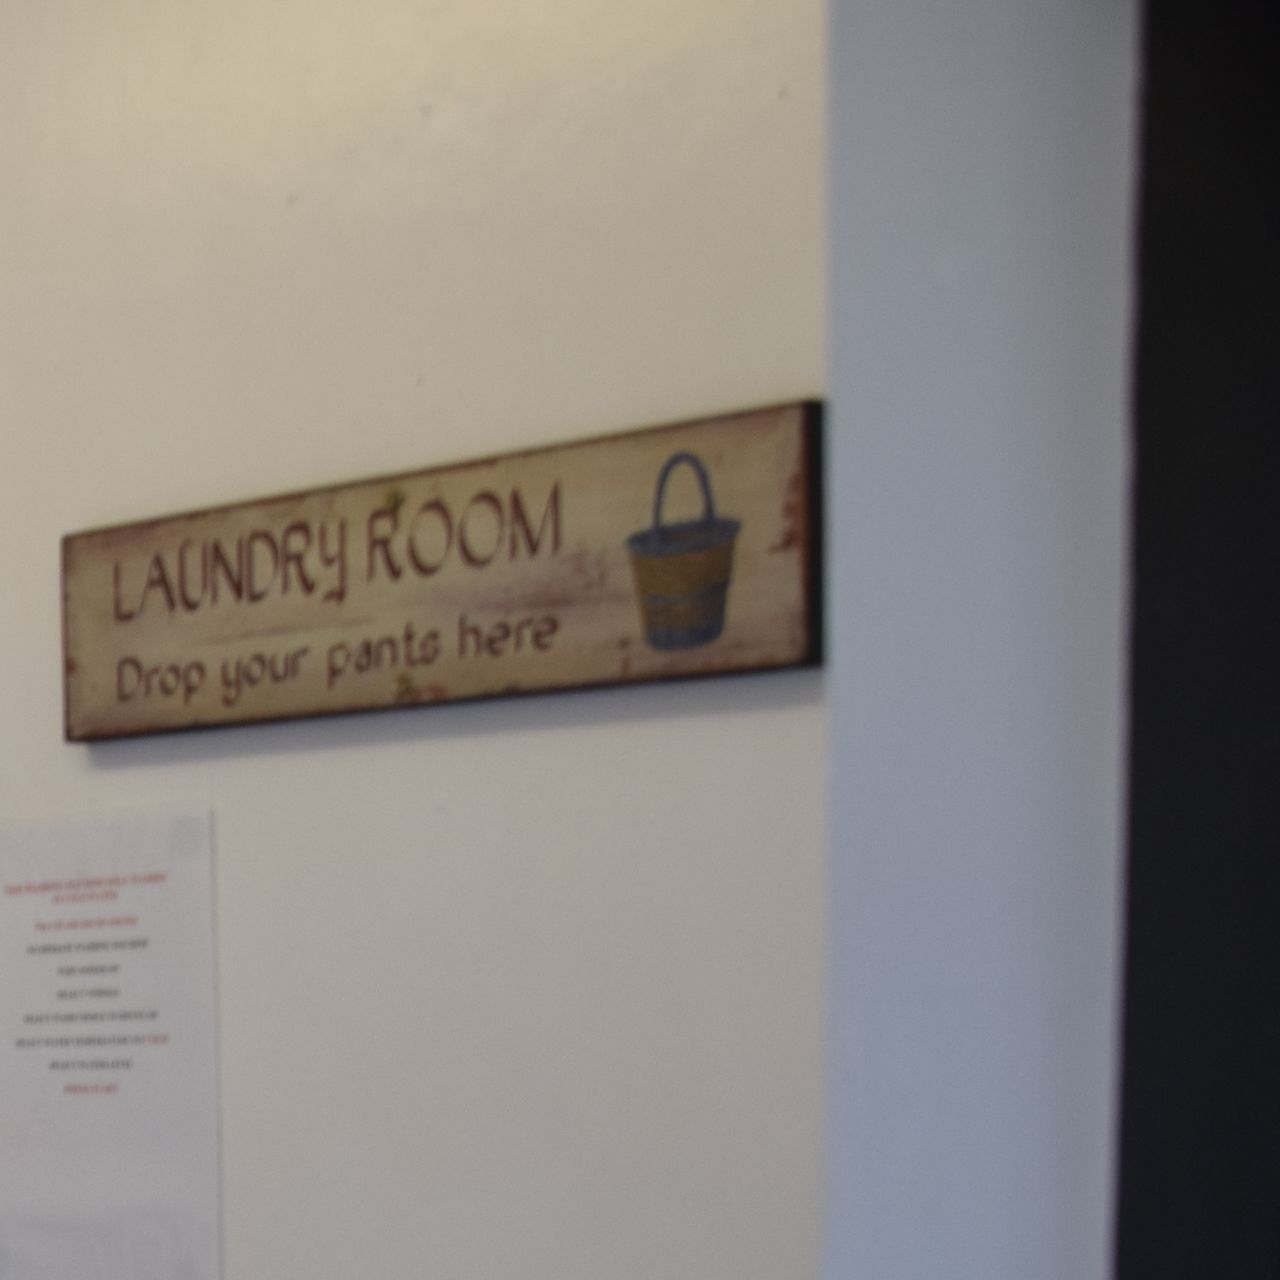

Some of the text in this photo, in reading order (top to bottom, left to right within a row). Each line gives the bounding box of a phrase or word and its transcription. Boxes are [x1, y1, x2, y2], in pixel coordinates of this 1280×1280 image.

[113, 480, 563, 623] LAUNDRY ROOM
[116, 611, 561, 707] Drop your pants here
